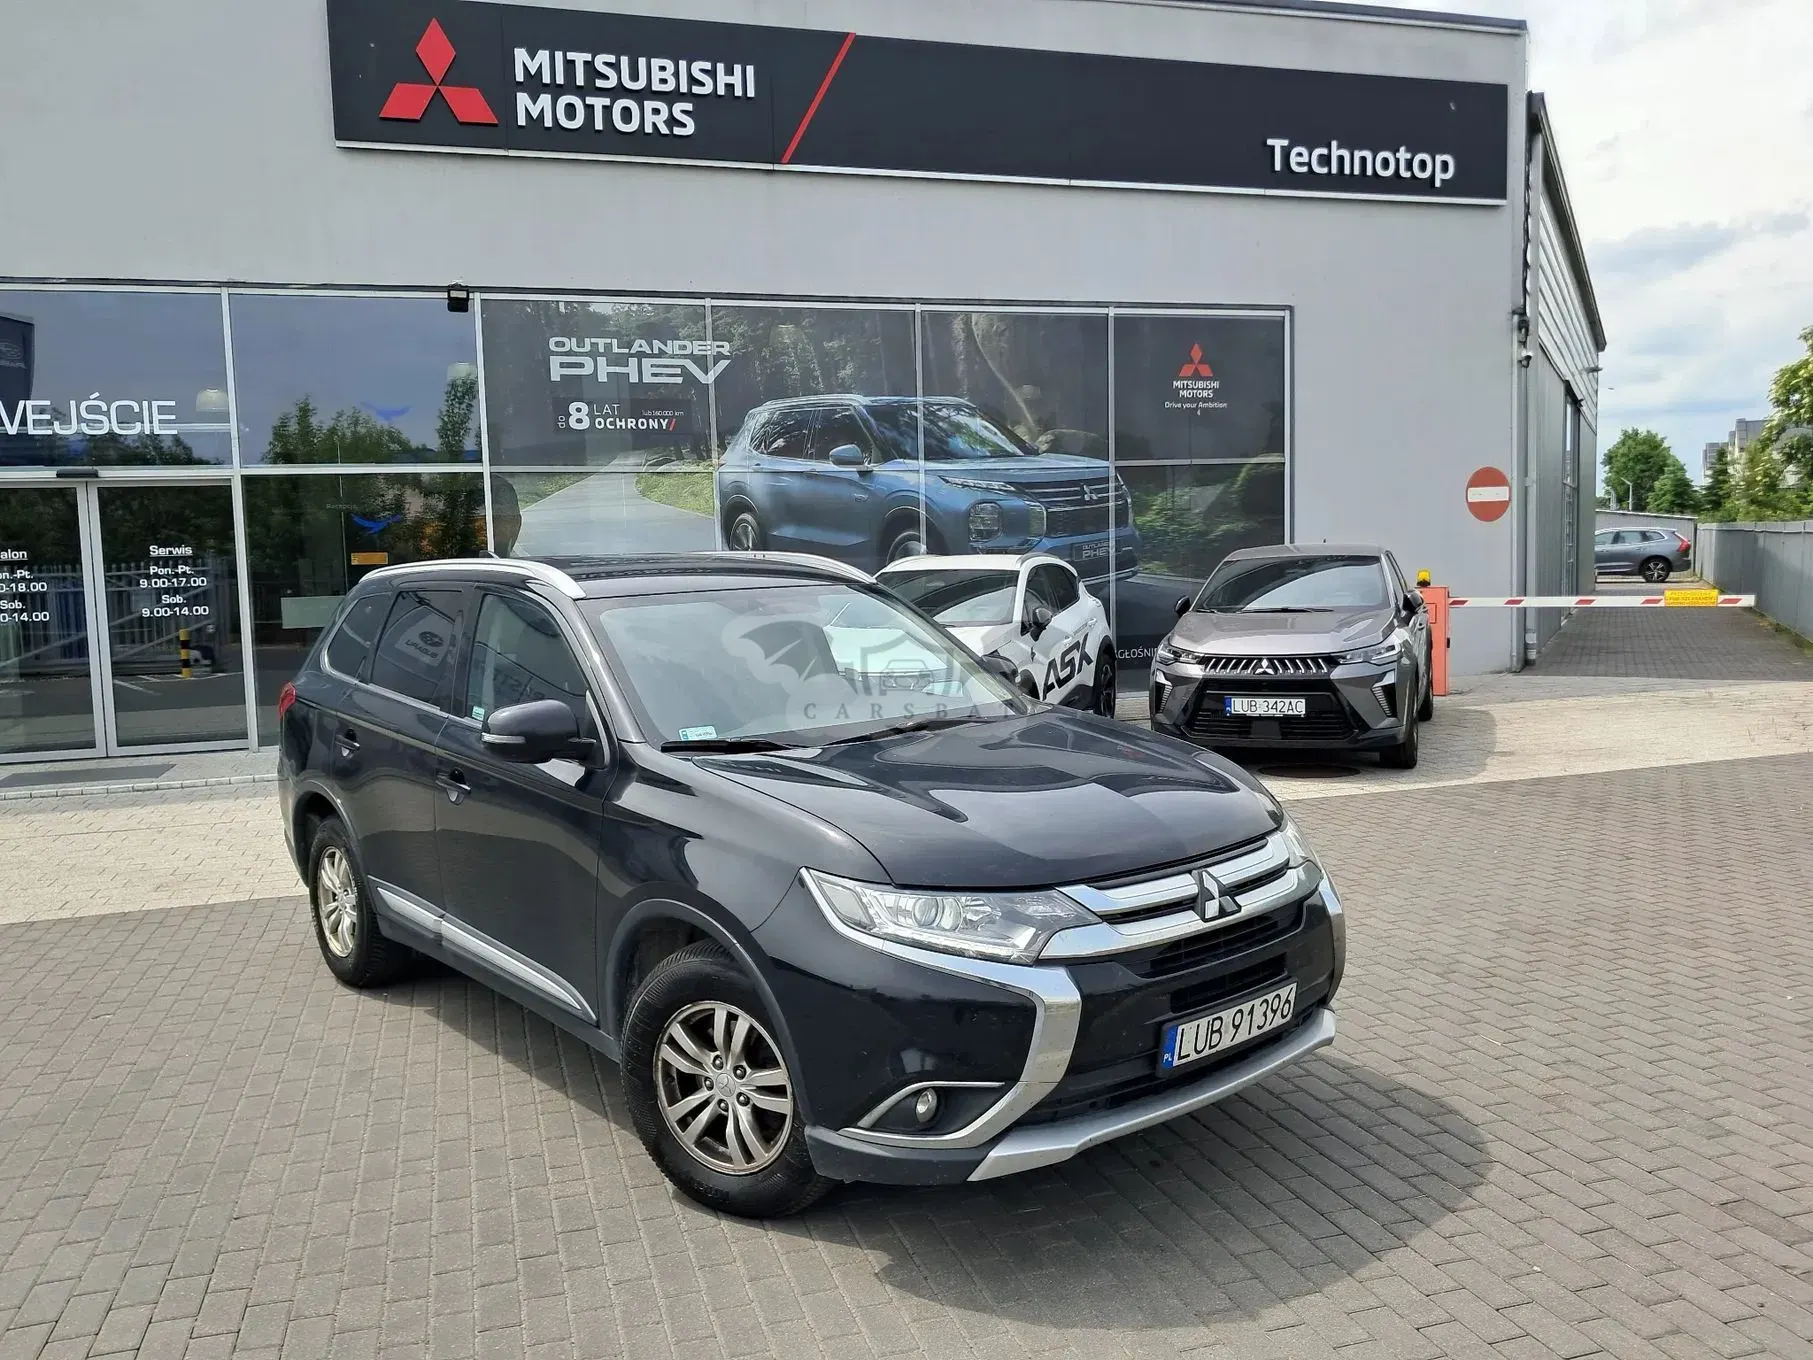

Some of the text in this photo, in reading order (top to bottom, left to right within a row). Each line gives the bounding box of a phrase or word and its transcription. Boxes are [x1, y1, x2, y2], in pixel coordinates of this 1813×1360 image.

[514, 47, 755, 98] MITSUBISHI
[516, 92, 695, 136] MOTORS
[1266, 138, 1455, 188] Technotop
[549, 336, 731, 356] OUTLANDER
[549, 355, 732, 385] PHEV
[1173, 381, 1220, 389] MITSUBISHI
[1179, 390, 1214, 398] MOTORS
[1164, 401, 1228, 410] Drive your Ambition
[568, 401, 591, 430] 8
[593, 403, 621, 416] LAT
[0, 548, 28, 560] alon
[149, 544, 193, 556] Serwis
[0, 581, 48, 593] 0-18.00
[139, 577, 207, 588] 9.00-17.00
[0, 599, 26, 610] Sob.
[161, 594, 187, 604] Sob.
[0, 611, 50, 623] 0-14.00
[141, 605, 210, 618] 9.00-14.00
[1115, 645, 1157, 659] GŁOŚNI
[1042, 632, 1094, 701] ASX
[1232, 699, 1304, 714] LUB 342AC
[1177, 986, 1294, 1061] LUB 91396
